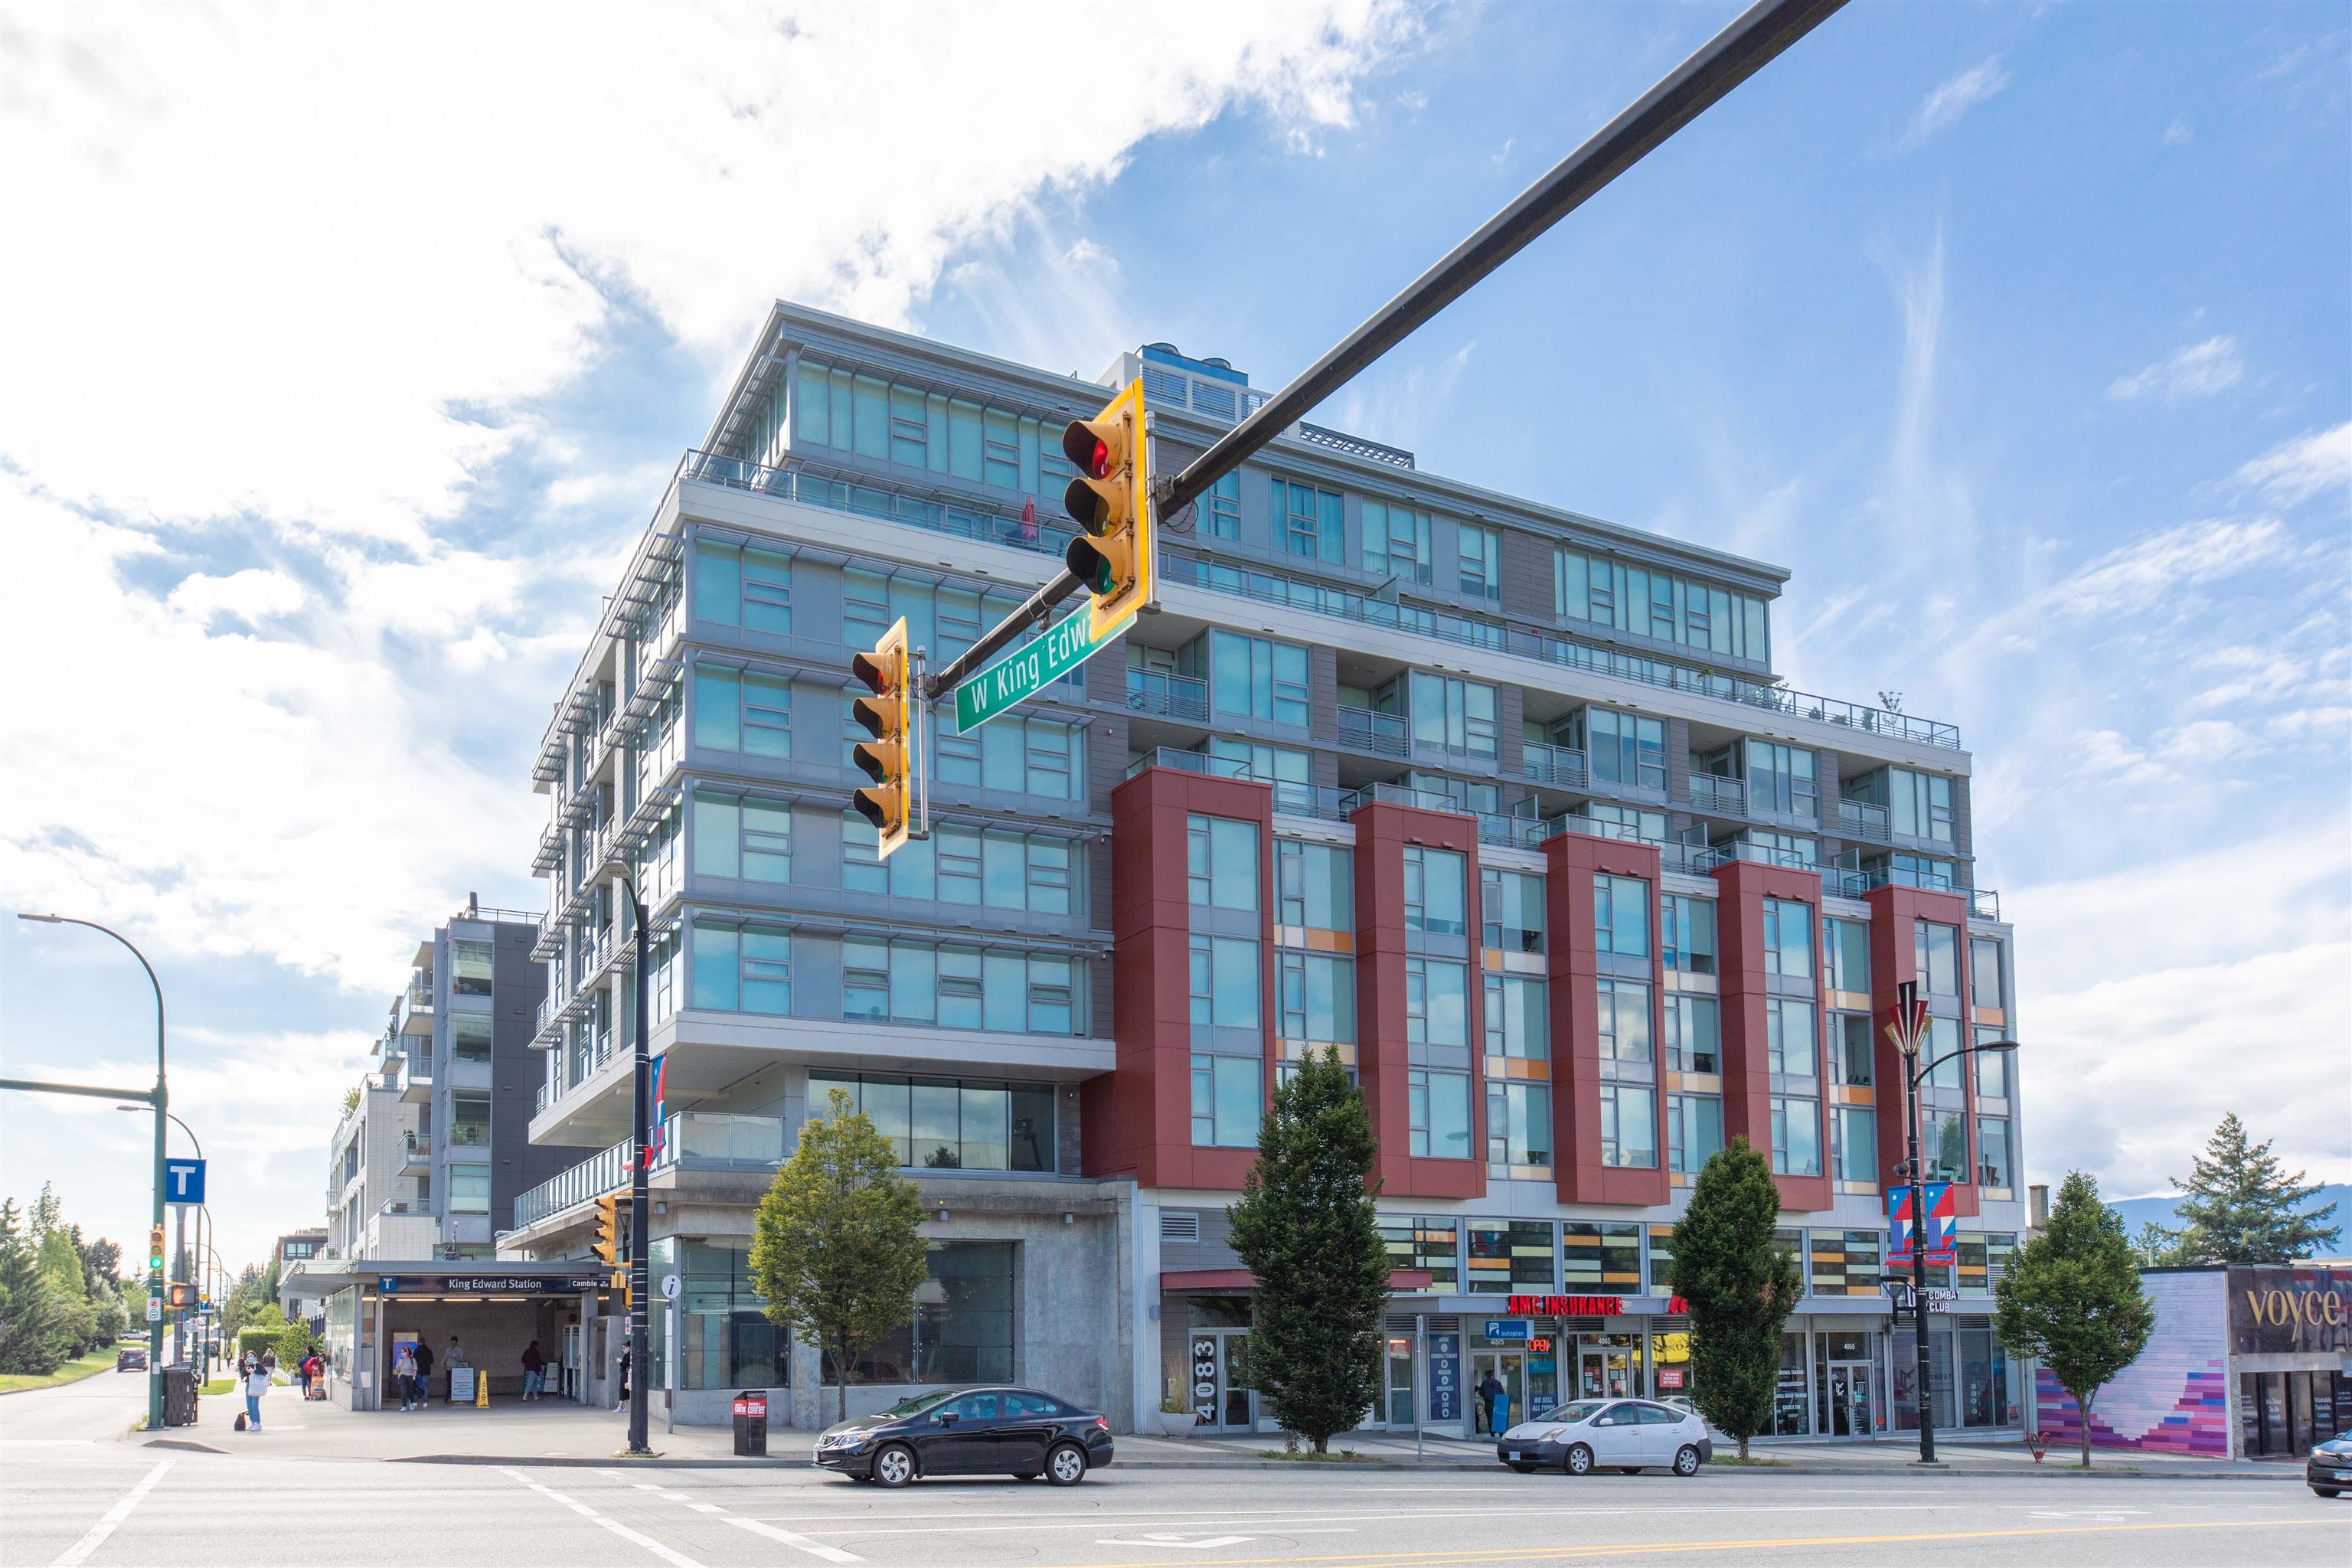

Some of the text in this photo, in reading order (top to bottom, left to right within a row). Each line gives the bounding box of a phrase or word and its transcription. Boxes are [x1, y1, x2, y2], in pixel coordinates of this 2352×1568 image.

[972, 615, 1092, 714] W King Edw
[170, 1165, 197, 1195] T
[384, 1278, 392, 1289] T
[449, 1279, 541, 1290] King Edward Station
[1929, 1291, 1960, 1300] COMBAT
[1509, 1295, 1622, 1315] AMC INSURANCE
[1929, 1302, 1949, 1312] CLUB
[2246, 1290, 2341, 1342] voyce
[1528, 1339, 1549, 1352] OPEN
[1194, 1341, 1215, 1420] 4083
